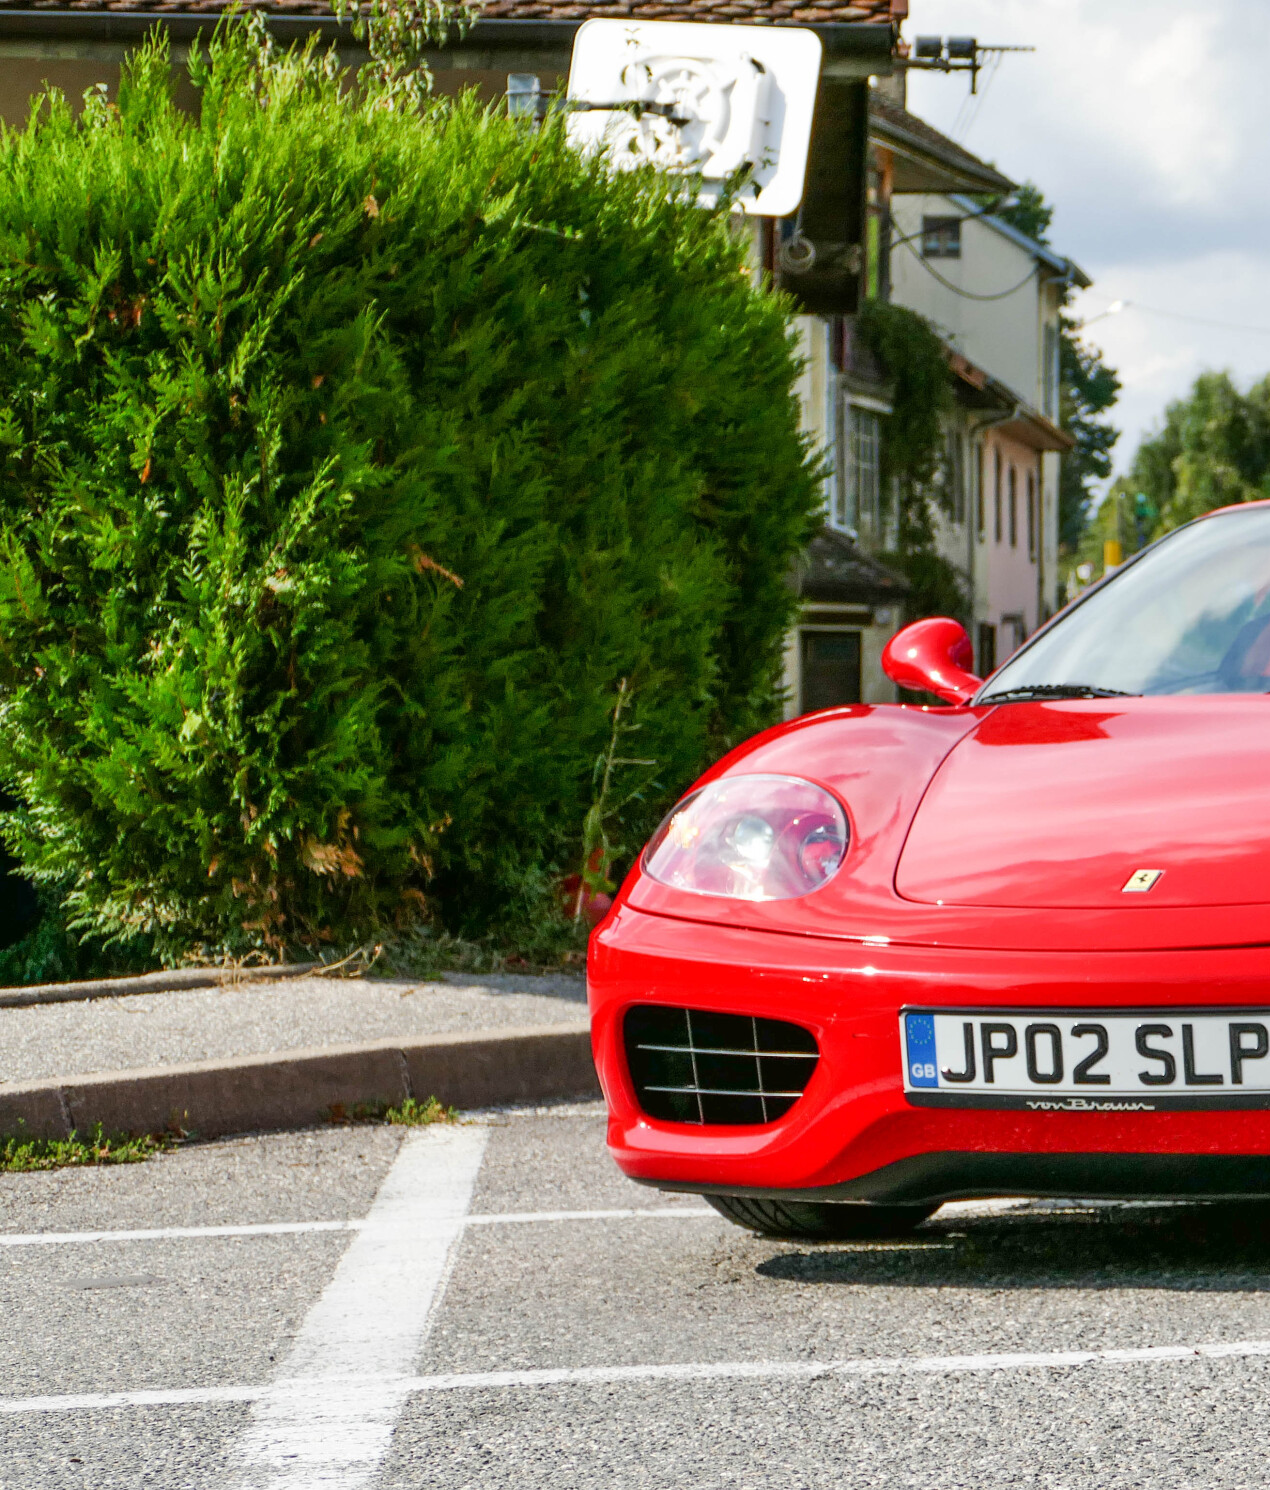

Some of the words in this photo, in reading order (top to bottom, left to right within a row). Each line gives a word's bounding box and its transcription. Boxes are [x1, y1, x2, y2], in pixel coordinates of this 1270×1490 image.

[911, 1063, 936, 1079] GB
[940, 1022, 1111, 1084] JP02
[1135, 1022, 1270, 1085] SLP
